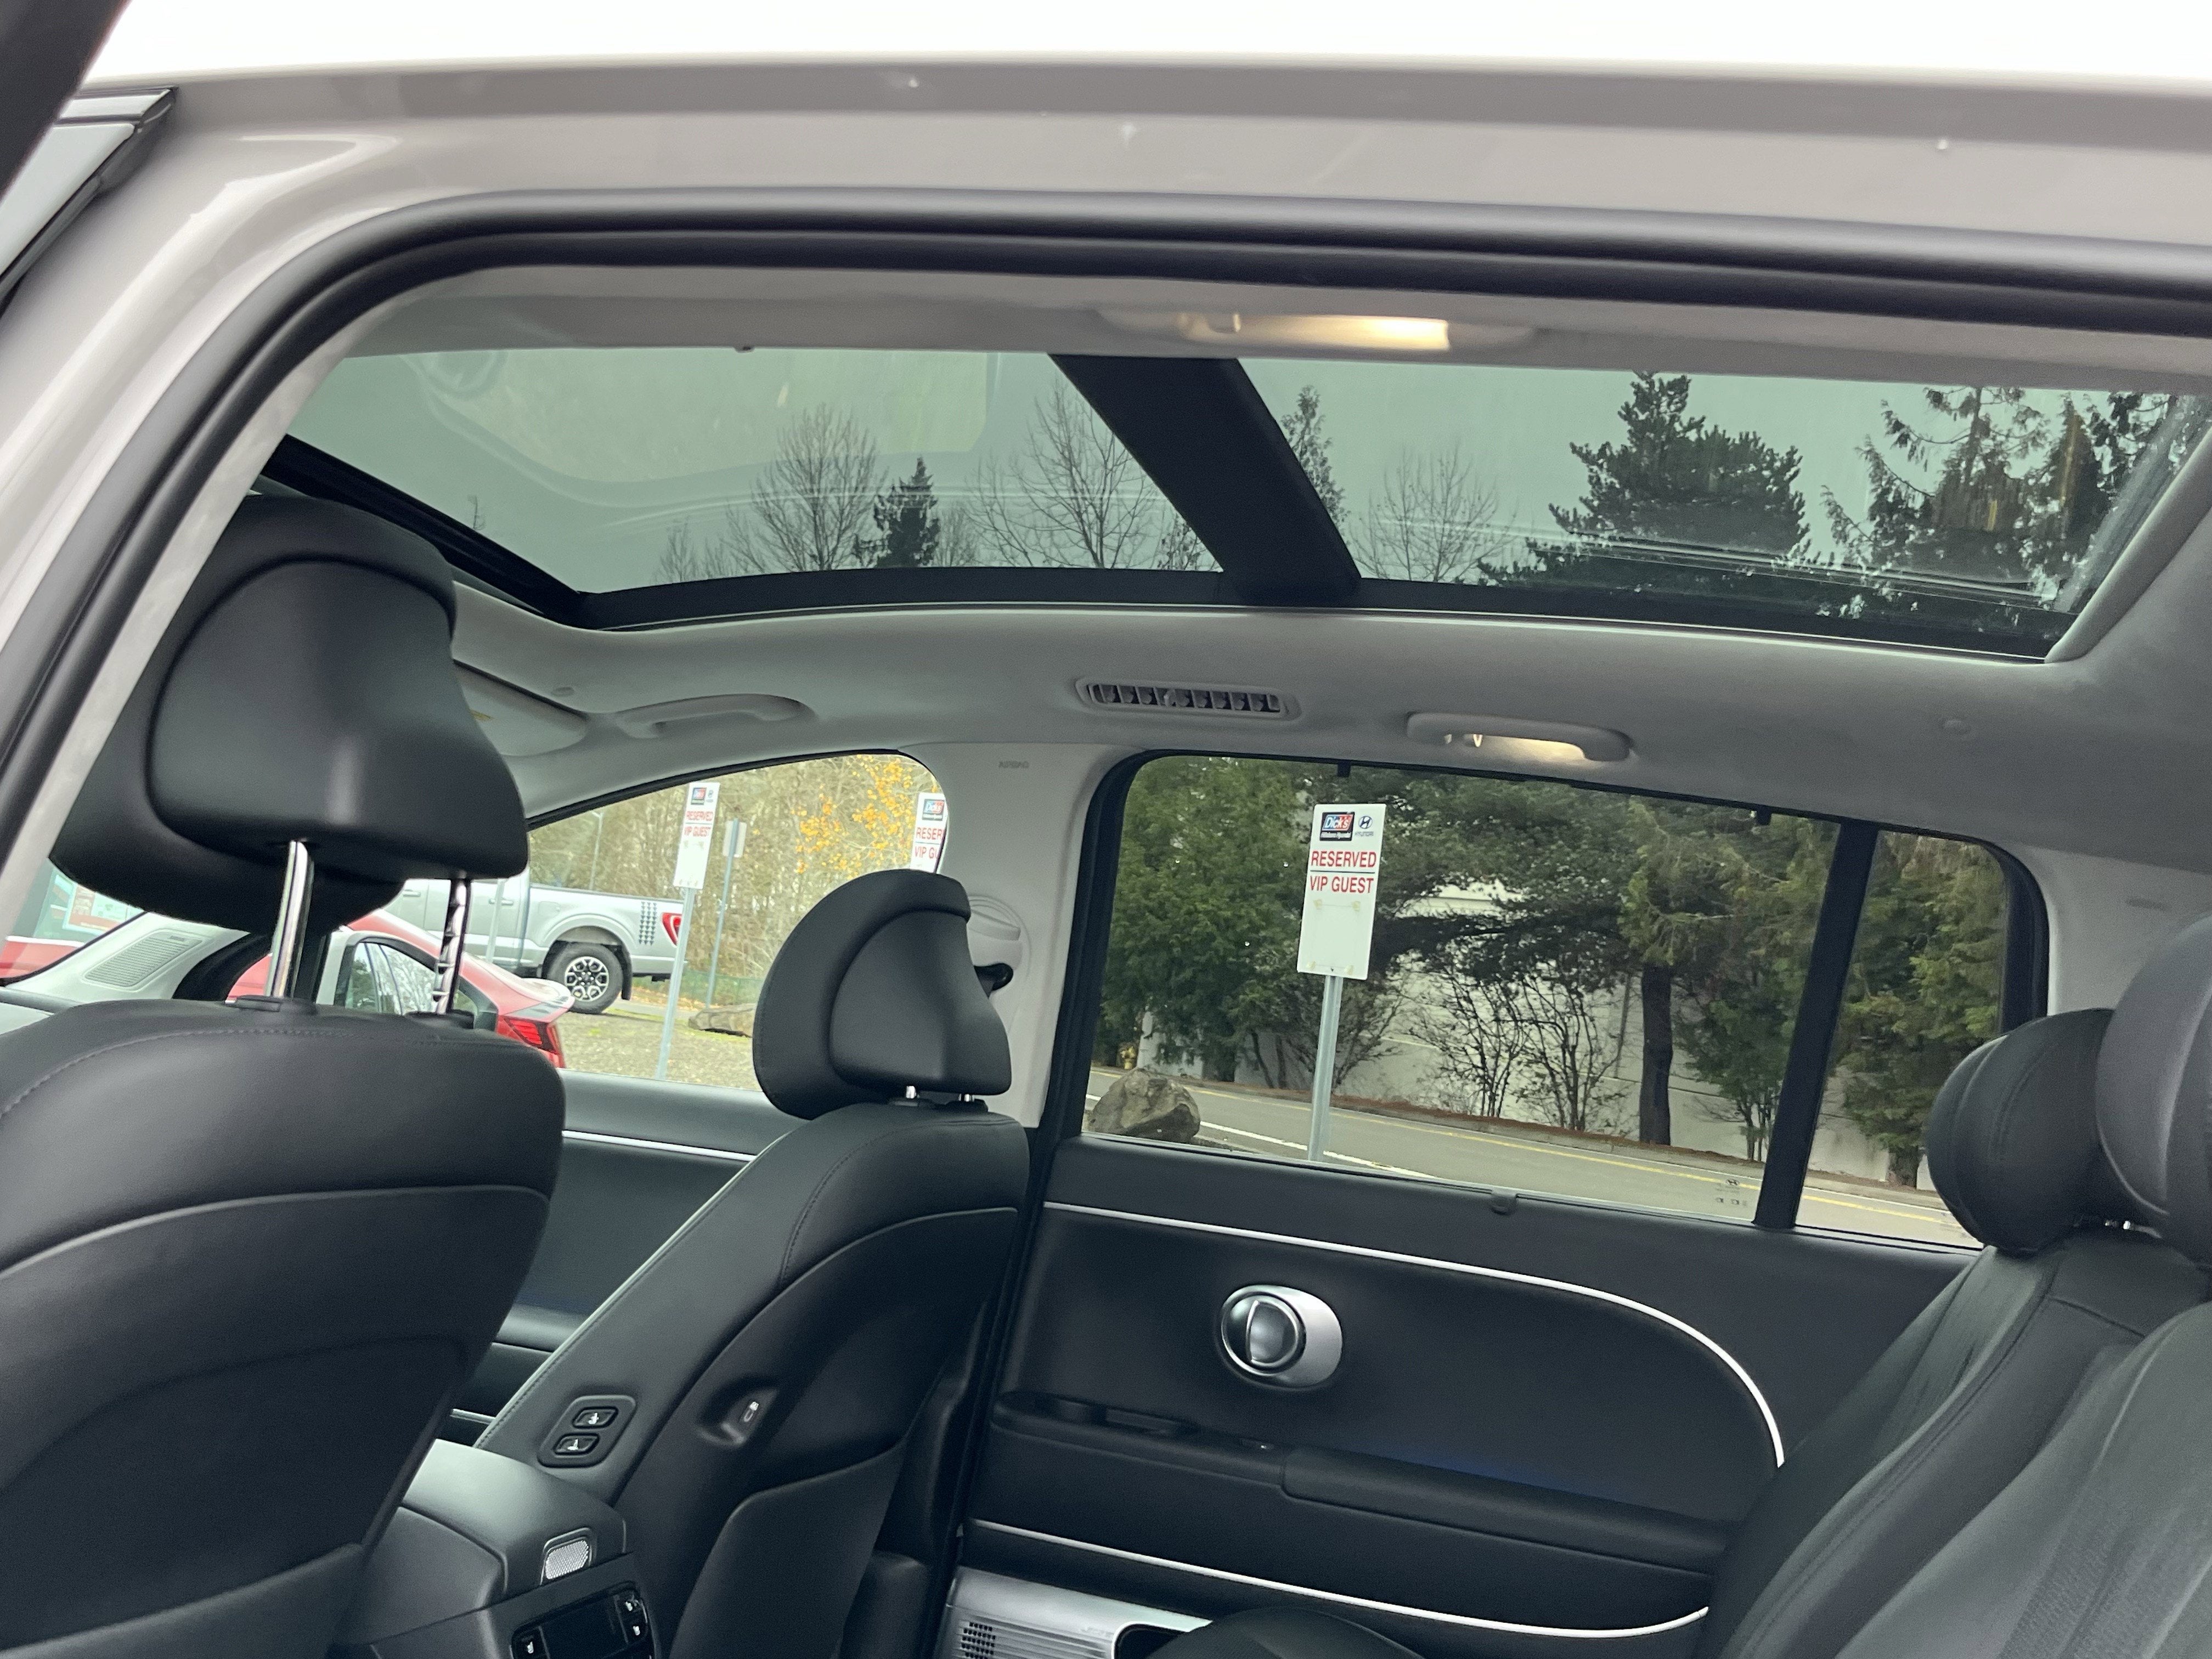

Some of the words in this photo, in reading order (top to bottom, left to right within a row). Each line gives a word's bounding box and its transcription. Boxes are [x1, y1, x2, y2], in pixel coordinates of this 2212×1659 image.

[916, 827, 944, 840] RESER
[915, 846, 927, 858] VIP
[1311, 851, 1376, 867] RESERVED
[1310, 876, 1328, 891] VIP
[1331, 876, 1374, 893] GUEST
